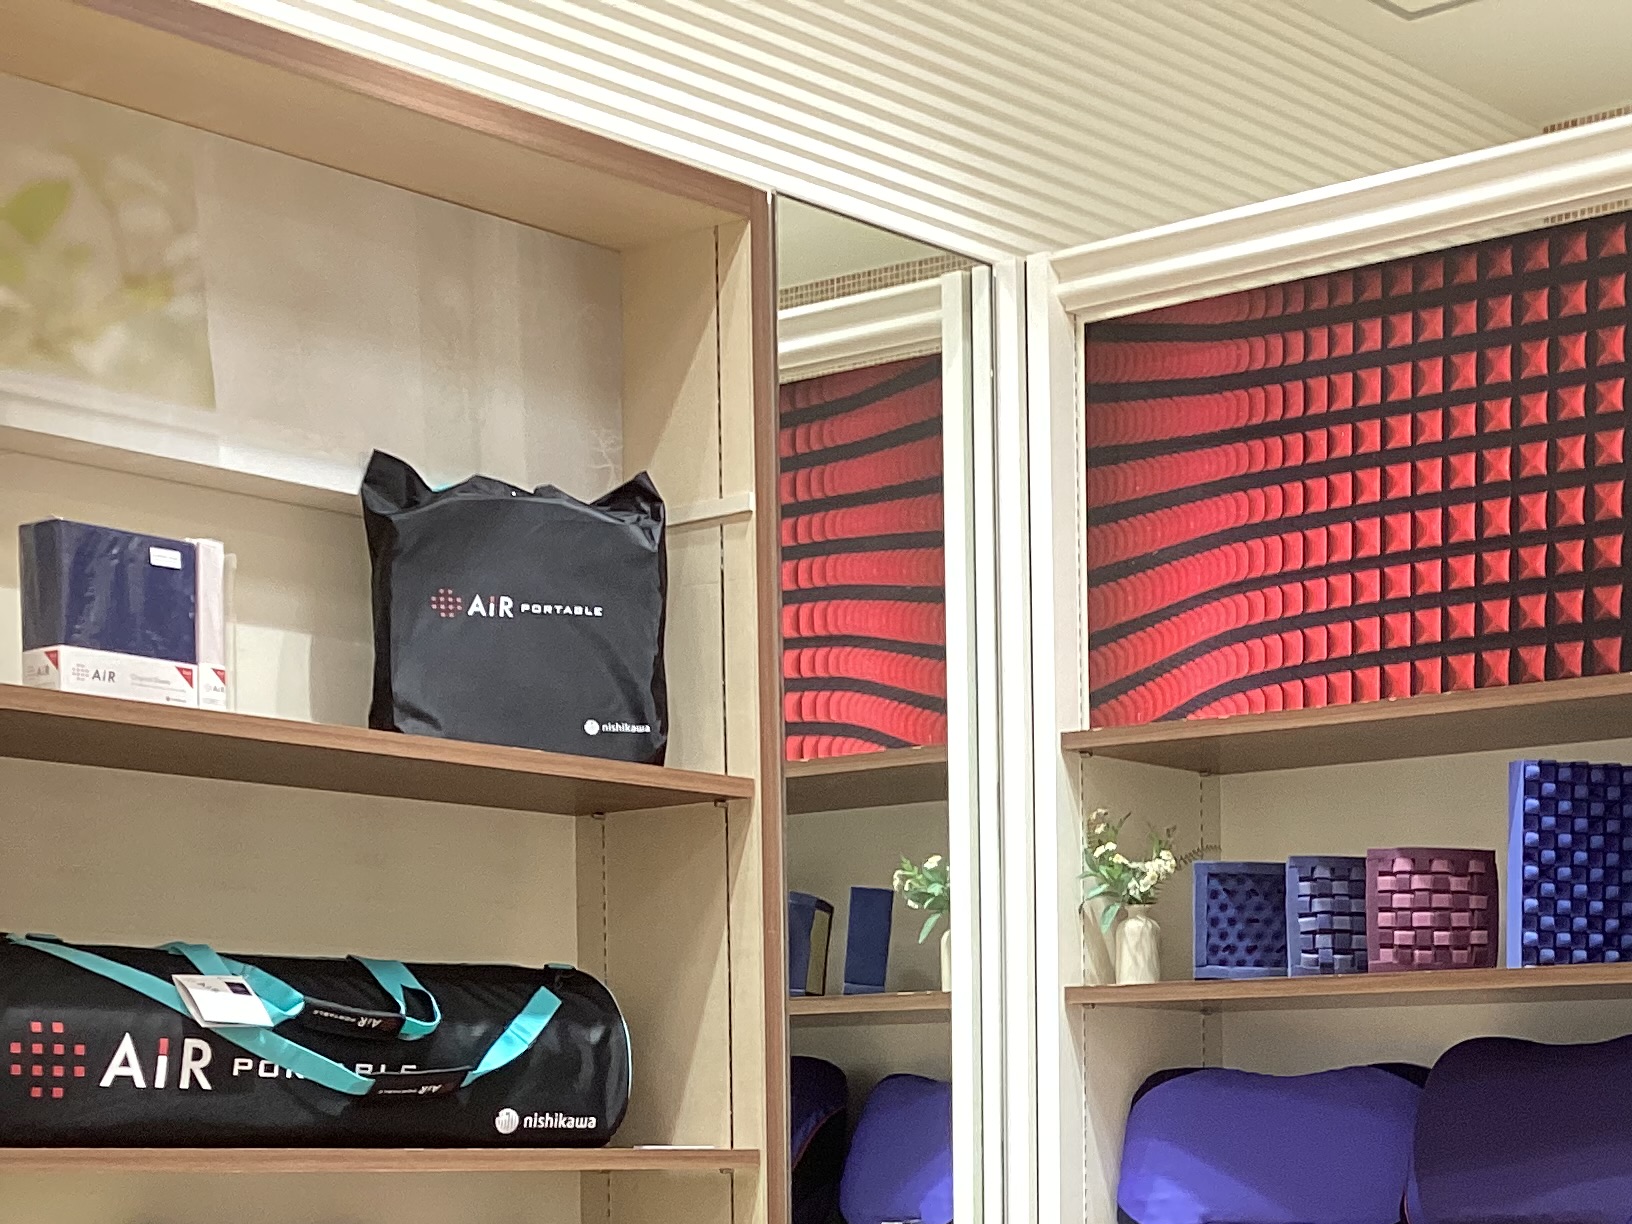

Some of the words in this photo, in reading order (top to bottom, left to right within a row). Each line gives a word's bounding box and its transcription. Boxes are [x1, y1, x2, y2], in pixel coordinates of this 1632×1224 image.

[520, 603, 603, 617] PORTABLE
[602, 723, 650, 734] nishikawa
[524, 1112, 597, 1129] nishikawa
